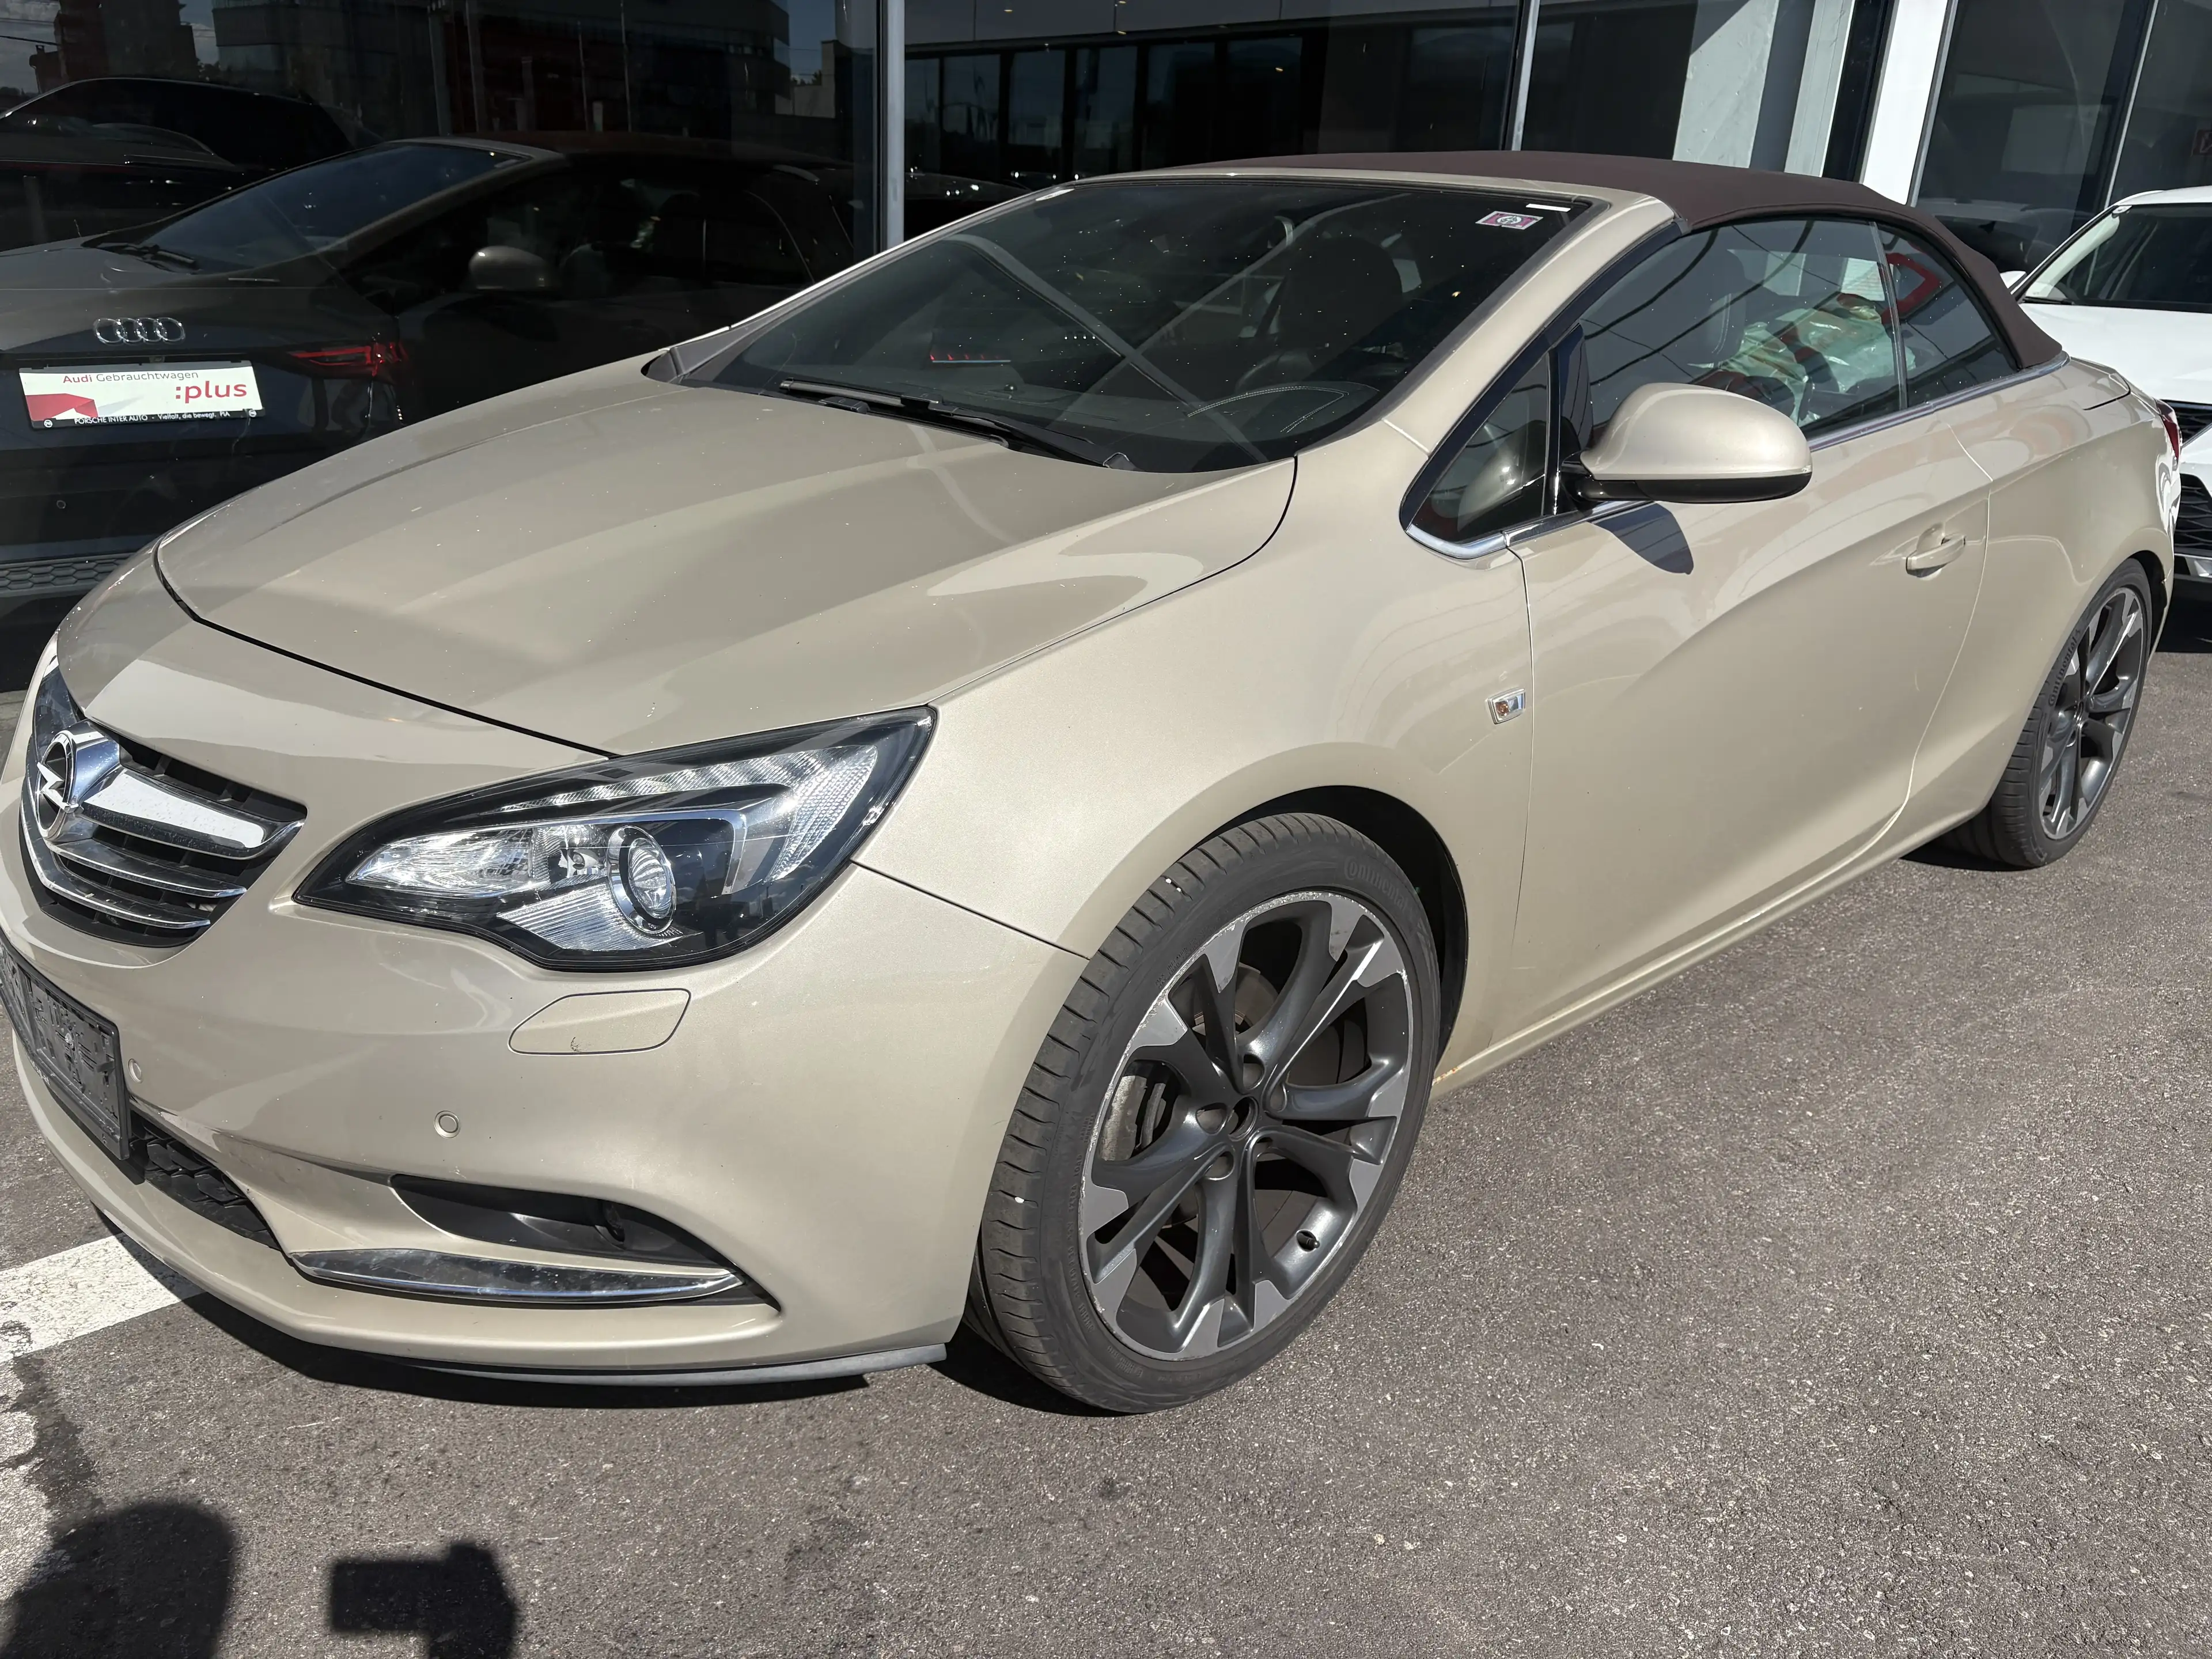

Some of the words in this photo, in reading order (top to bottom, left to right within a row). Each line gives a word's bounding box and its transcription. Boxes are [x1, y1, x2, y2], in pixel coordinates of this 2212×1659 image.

[63, 375, 92, 383] Audi
[96, 372, 199, 382] Gebrauchtwagen
[175, 380, 248, 404] :plus
[74, 416, 107, 425] PORSCHE
[108, 415, 128, 423] INTER
[128, 414, 148, 422] AUTO
[2048, 635, 2078, 707] Continental
[1344, 855, 1408, 914] Continental
